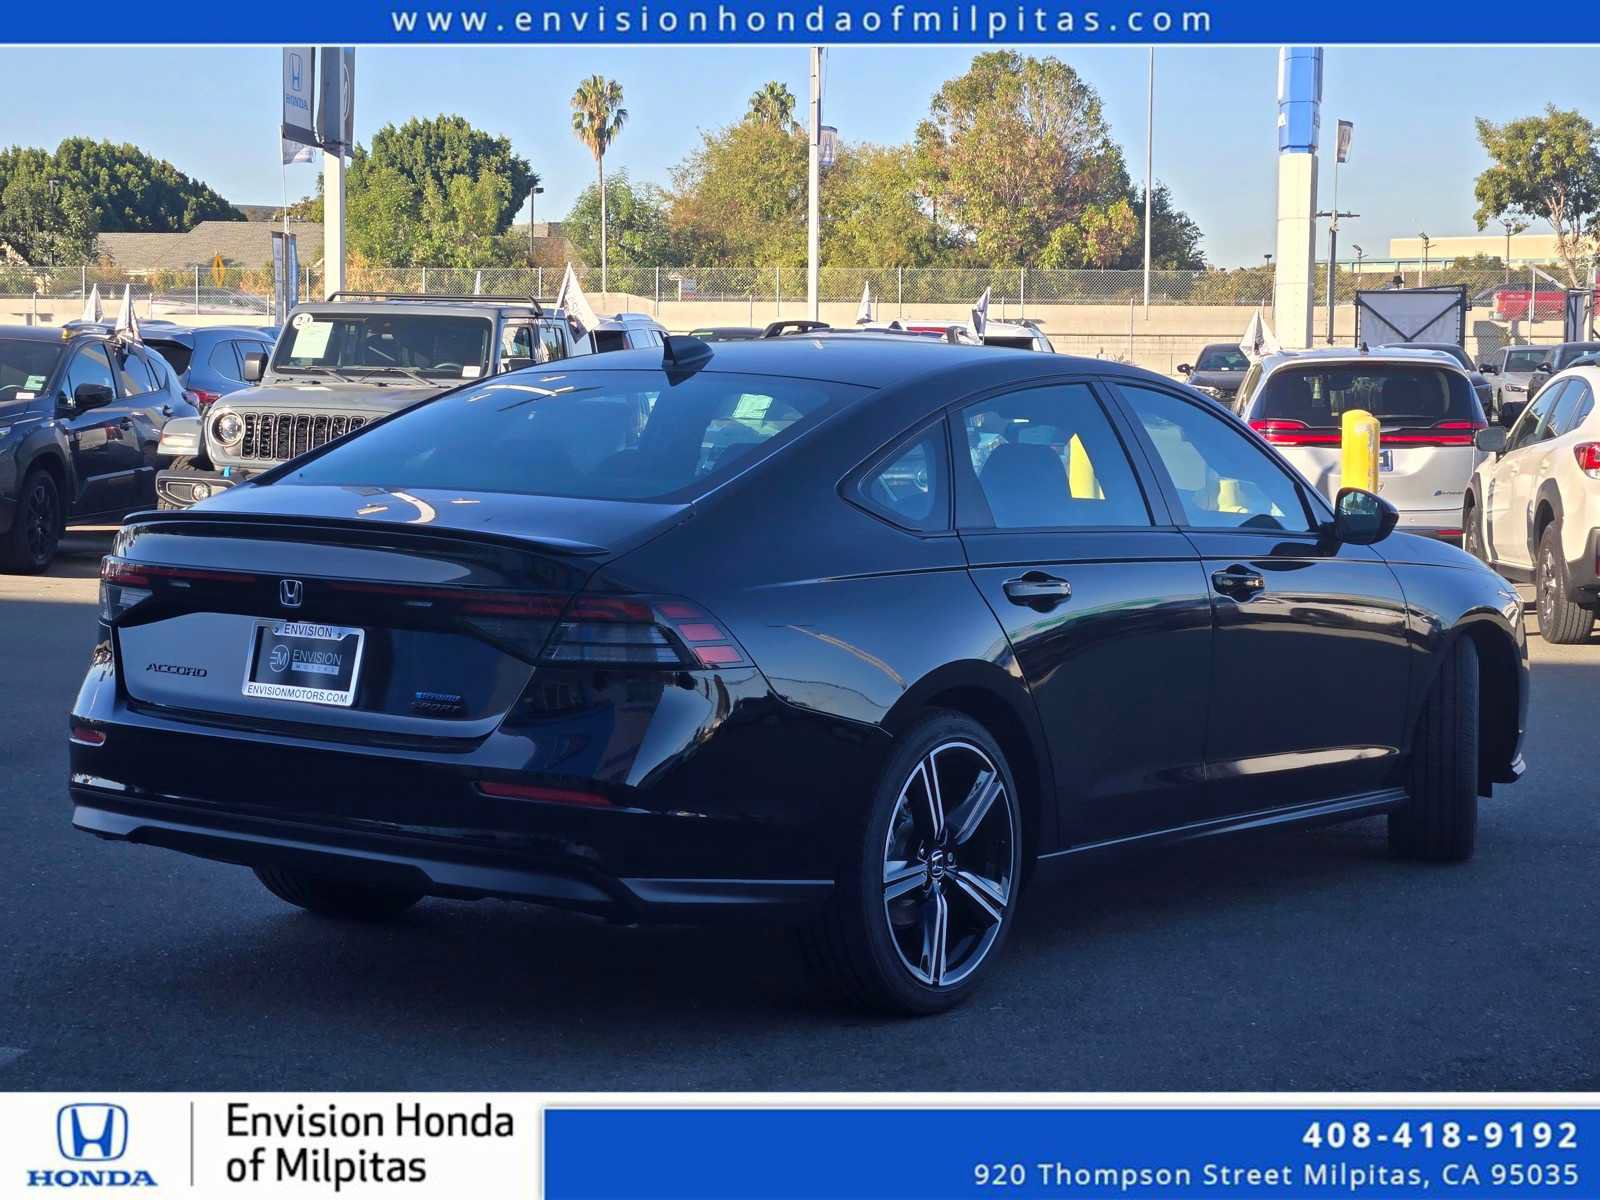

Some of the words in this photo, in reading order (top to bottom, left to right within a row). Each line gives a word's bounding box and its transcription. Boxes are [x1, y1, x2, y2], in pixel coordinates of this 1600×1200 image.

[284, 624, 332, 638] ENVISION
[293, 649, 342, 666] ENVISION
[146, 663, 208, 678] ACCORD
[247, 684, 348, 703] ENVISIONMOTORS.COM
